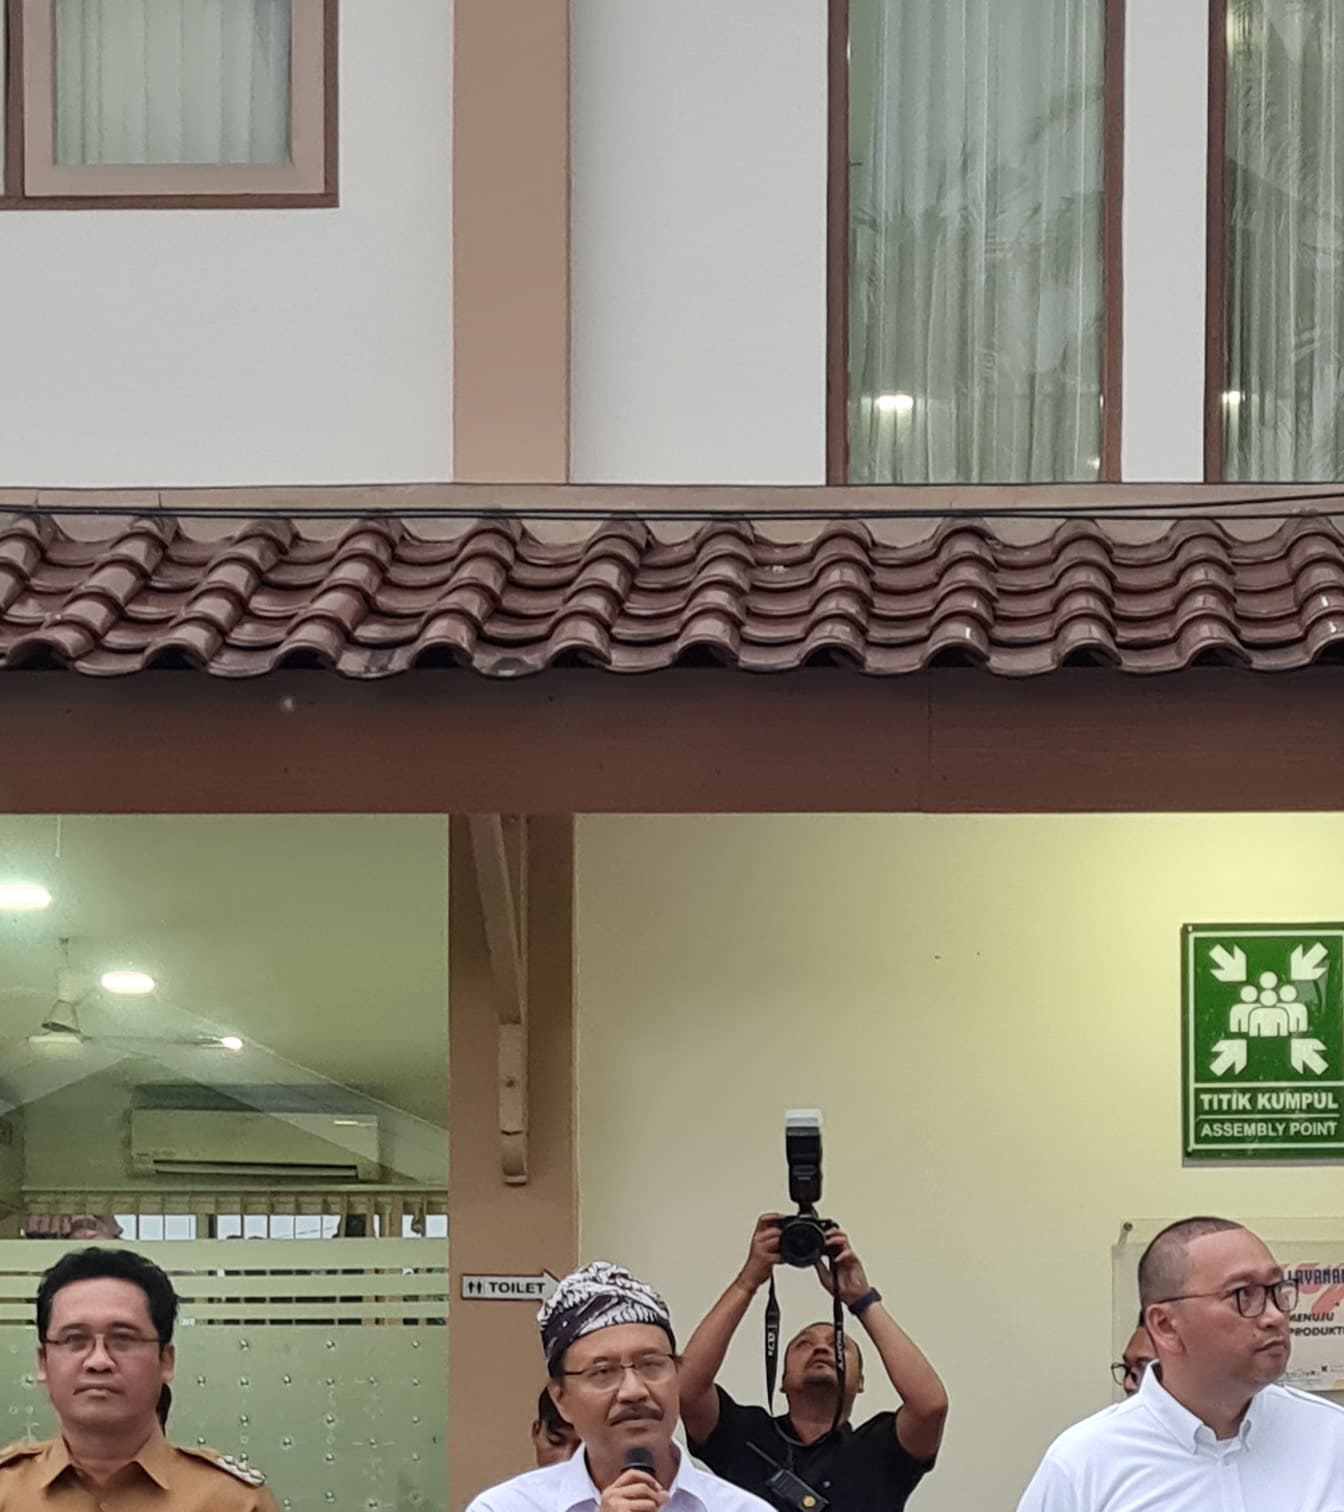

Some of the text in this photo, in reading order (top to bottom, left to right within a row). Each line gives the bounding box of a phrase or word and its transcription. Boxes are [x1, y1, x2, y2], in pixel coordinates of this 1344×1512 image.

[1200, 1092, 1339, 1110] TITIK KUMPUL
[1200, 1121, 1338, 1137] ASSEMBLY POINT
[488, 1282, 546, 1294] TOILET
